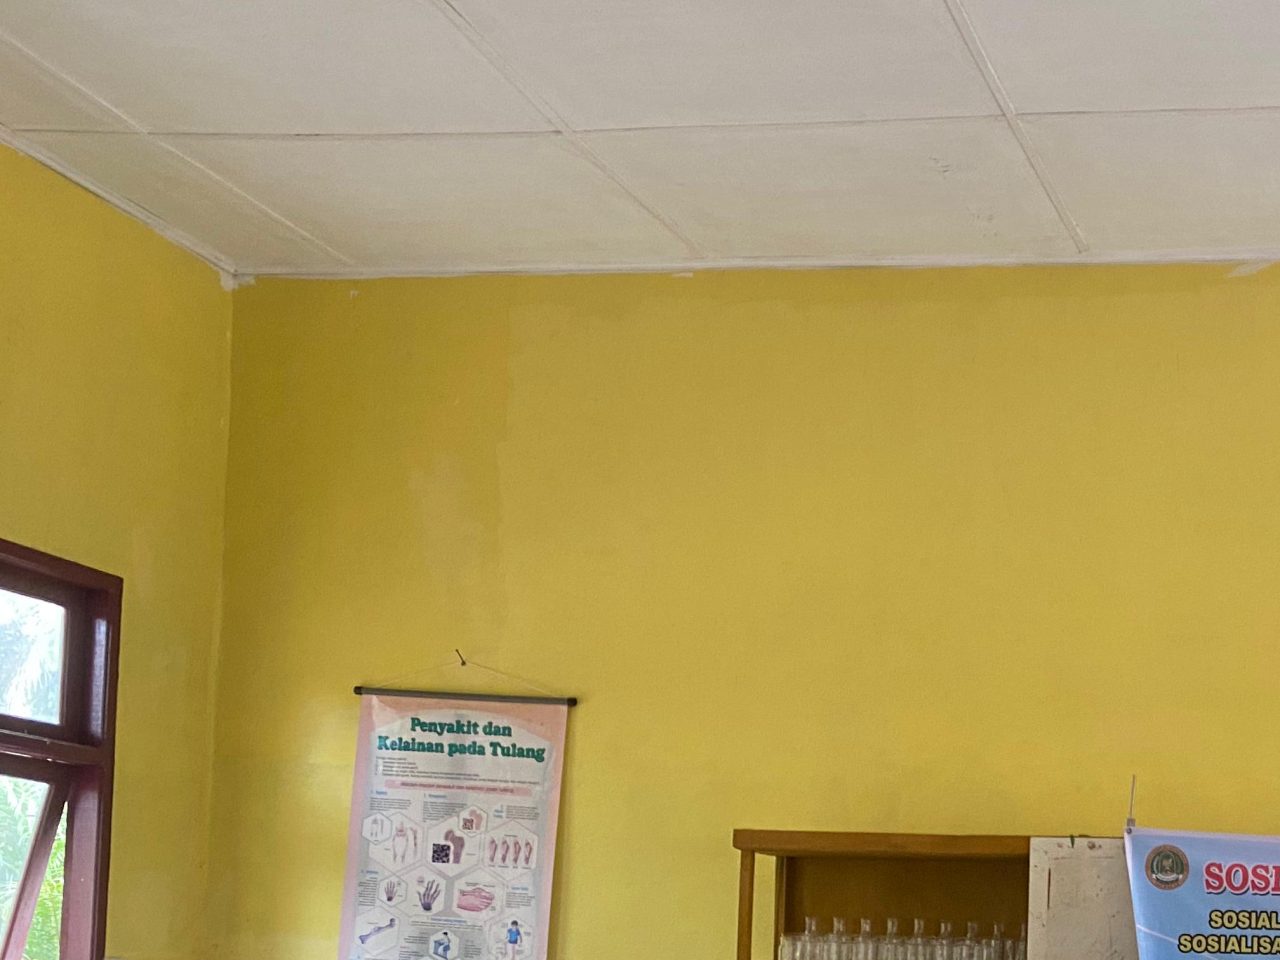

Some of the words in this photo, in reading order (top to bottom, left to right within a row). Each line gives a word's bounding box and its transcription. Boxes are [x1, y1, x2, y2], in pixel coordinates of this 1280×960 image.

[410, 717, 479, 736] Penyakit
[482, 721, 512, 737] dan
[377, 735, 445, 753] Kelainan
[447, 740, 486, 757] pada
[489, 742, 546, 762] Tulang
